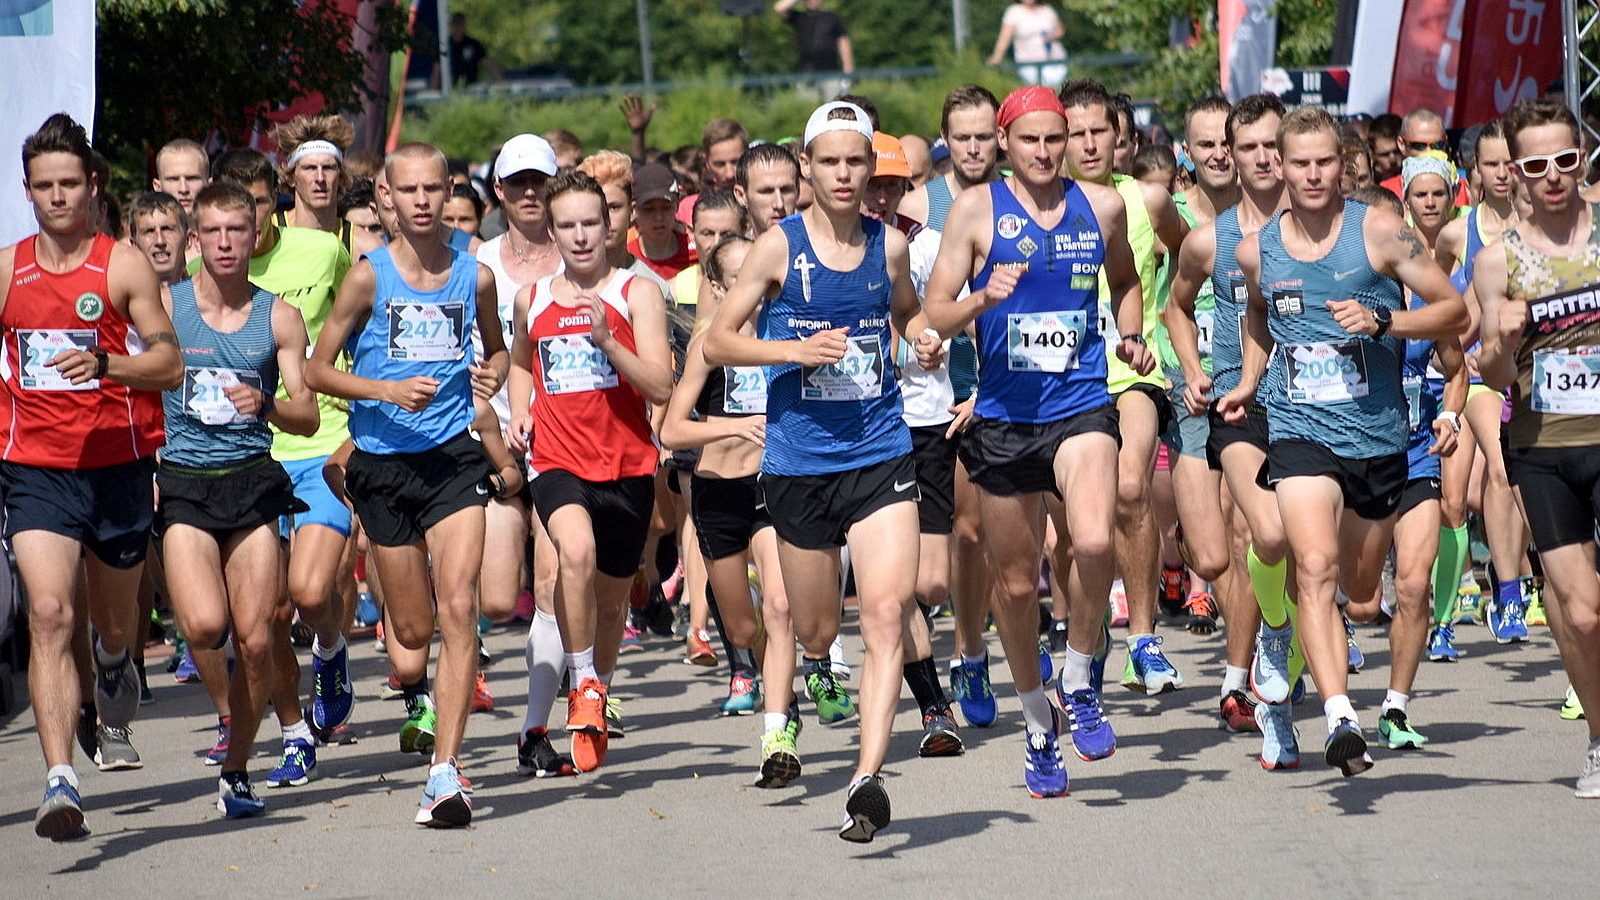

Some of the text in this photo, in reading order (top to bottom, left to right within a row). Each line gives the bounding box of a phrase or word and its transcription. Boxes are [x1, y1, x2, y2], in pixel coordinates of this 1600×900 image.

[400, 320, 454, 339] 2471
[1021, 330, 1078, 348] 1403
[1546, 370, 1600, 391] 1347
